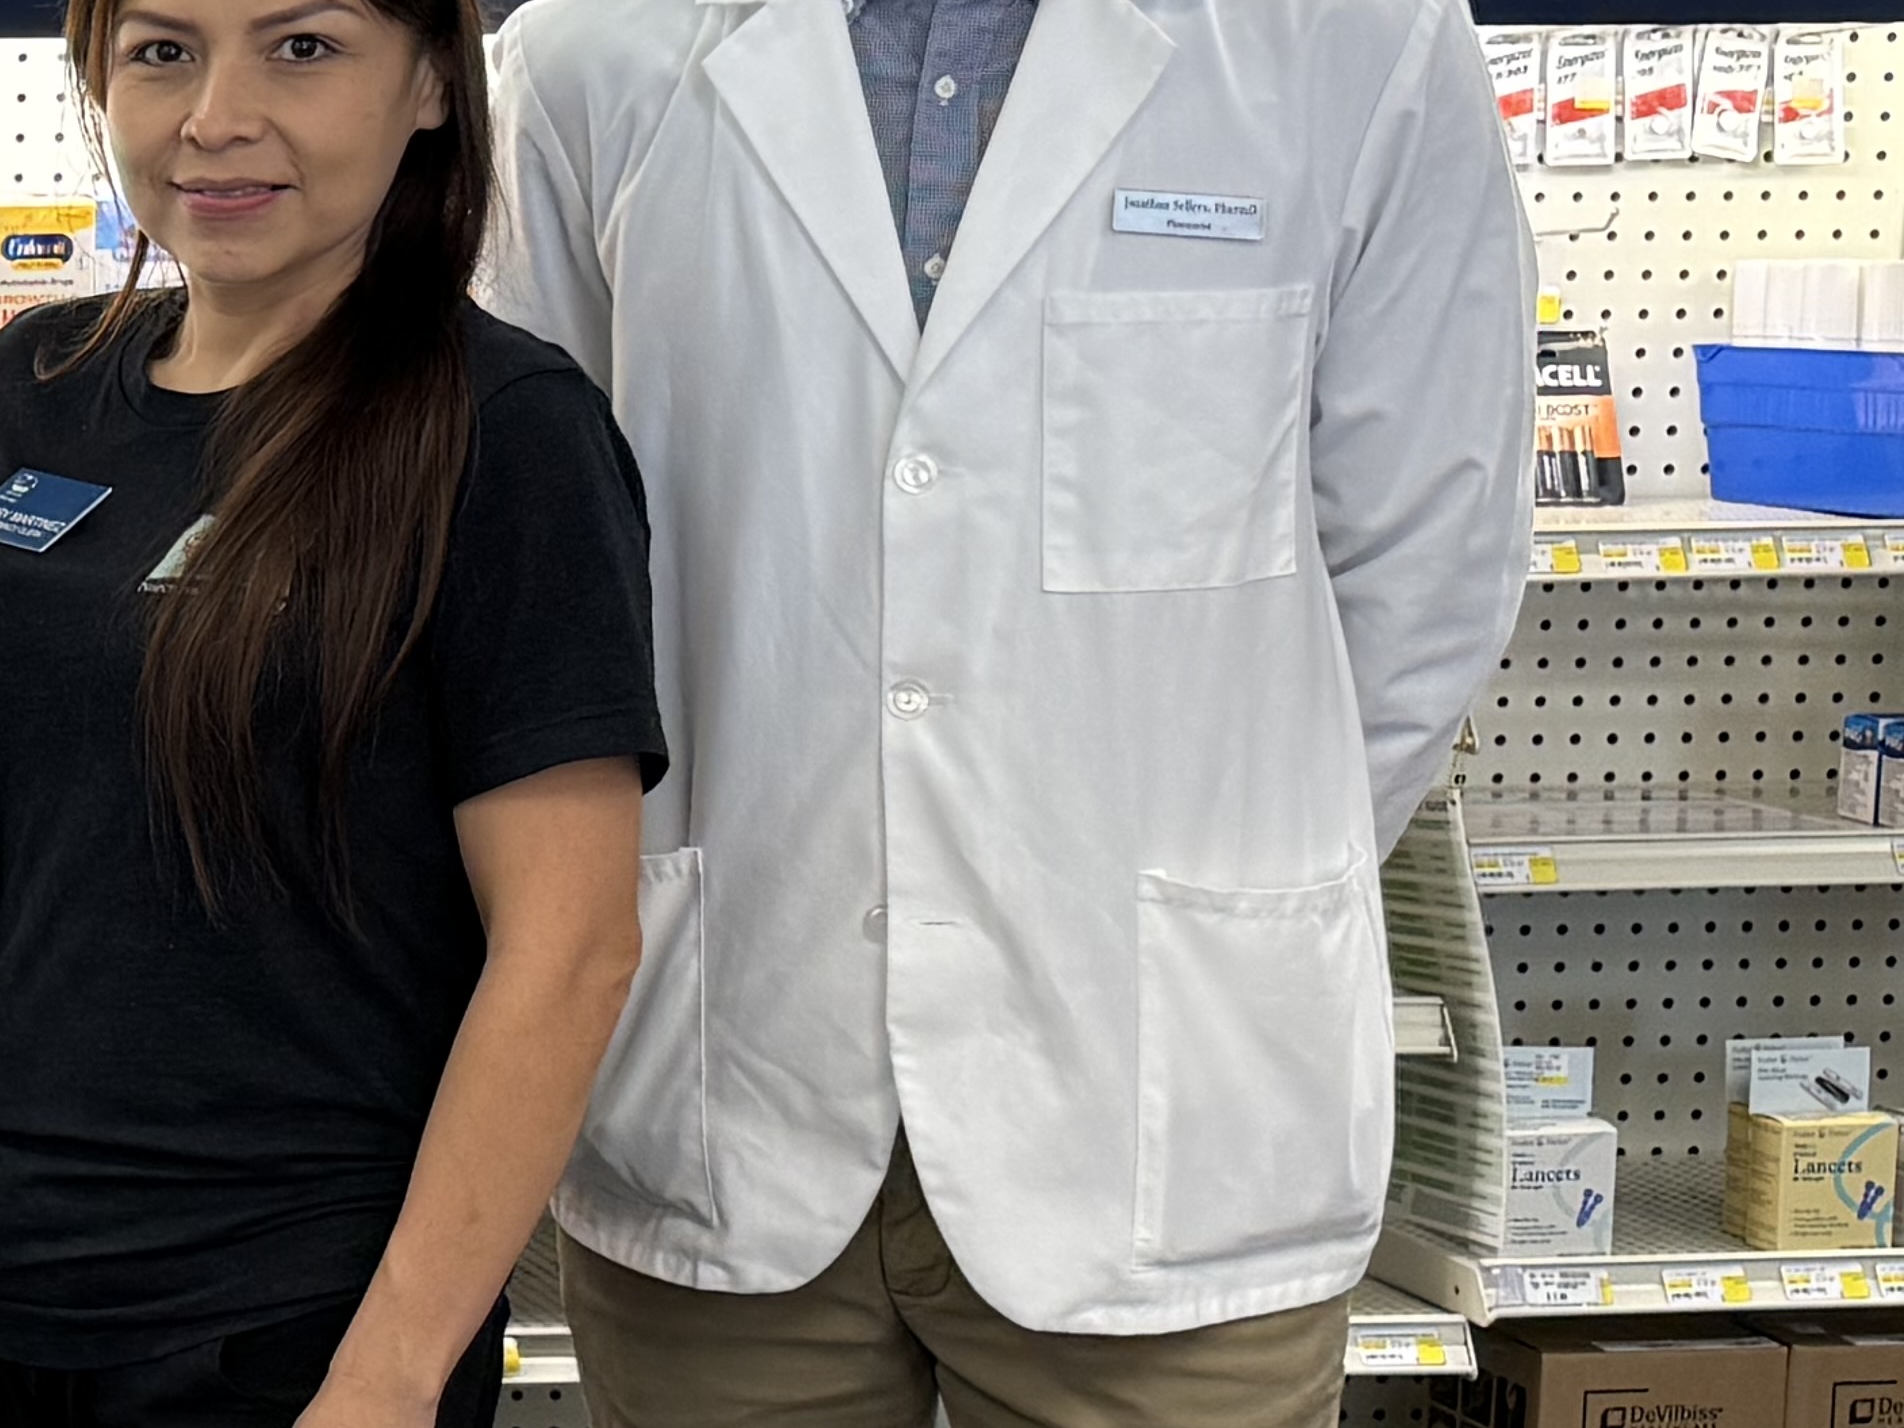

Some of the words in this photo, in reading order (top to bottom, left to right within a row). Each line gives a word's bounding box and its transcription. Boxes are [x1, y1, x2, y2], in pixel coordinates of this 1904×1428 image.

[1511, 1163, 1581, 1183] Lancets
[1792, 1158, 1863, 1175] Lancets
[1630, 1405, 1718, 1423] DeVilbiss
